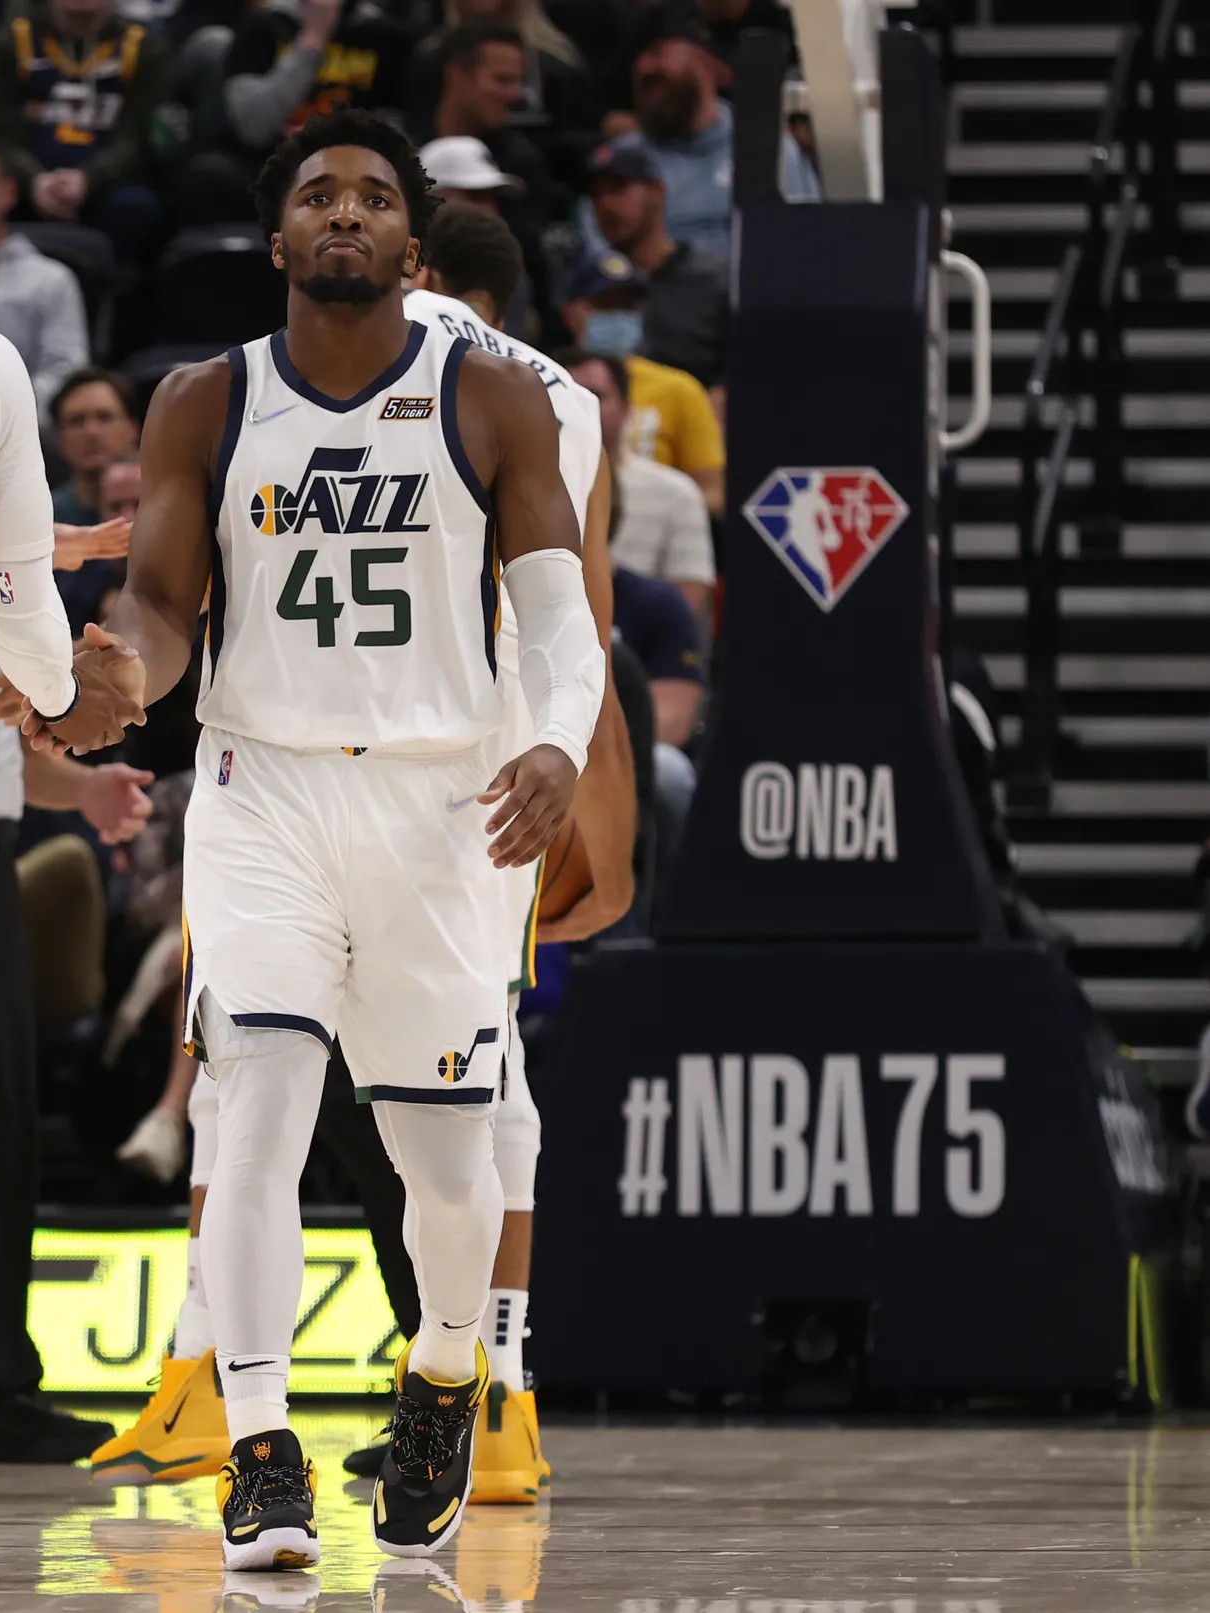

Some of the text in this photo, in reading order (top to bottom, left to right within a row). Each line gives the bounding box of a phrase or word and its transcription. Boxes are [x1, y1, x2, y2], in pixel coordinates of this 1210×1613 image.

[384, 400, 400, 417] 5
[399, 409, 430, 417] FIGHT
[250, 445, 431, 536] JAZZ
[276, 547, 412, 648] 45
[741, 761, 898, 862] @NBA
